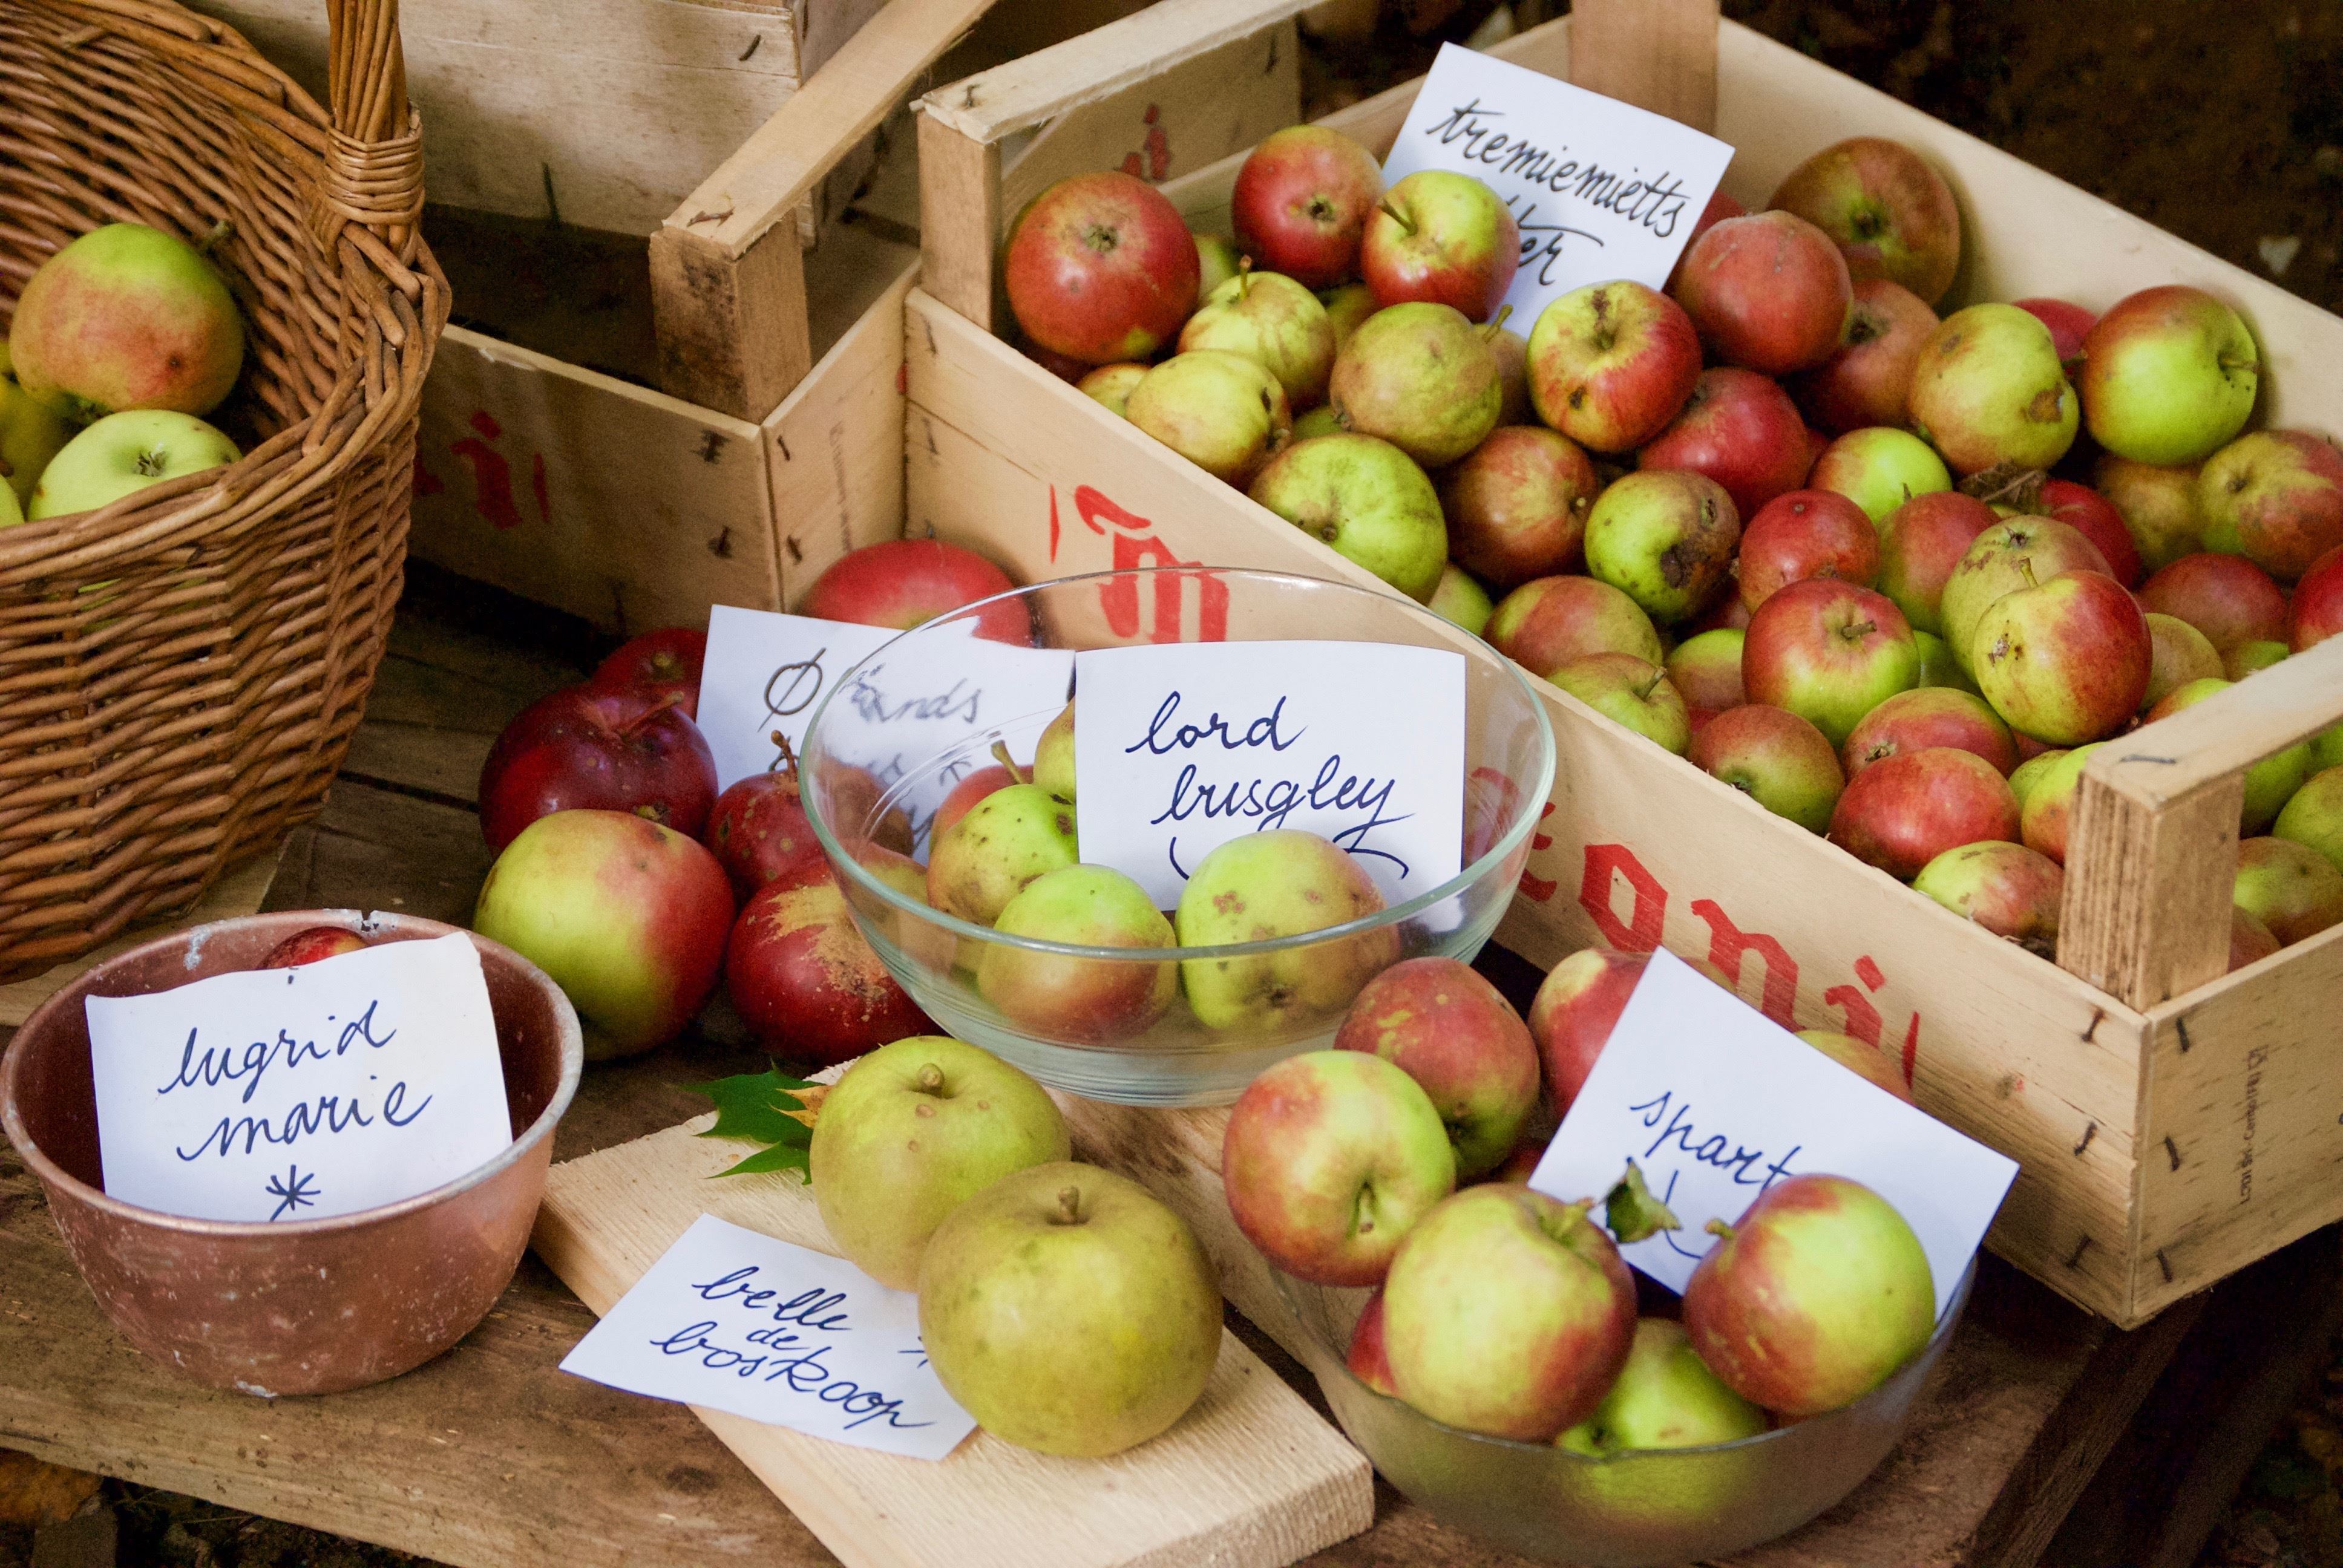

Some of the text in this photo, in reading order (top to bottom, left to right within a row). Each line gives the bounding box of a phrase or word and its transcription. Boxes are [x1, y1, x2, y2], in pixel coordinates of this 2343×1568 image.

[1124, 690, 1309, 754] lord
[175, 1075, 434, 1162] marie
[691, 1265, 852, 1331] belle
[746, 1327, 811, 1351] de
